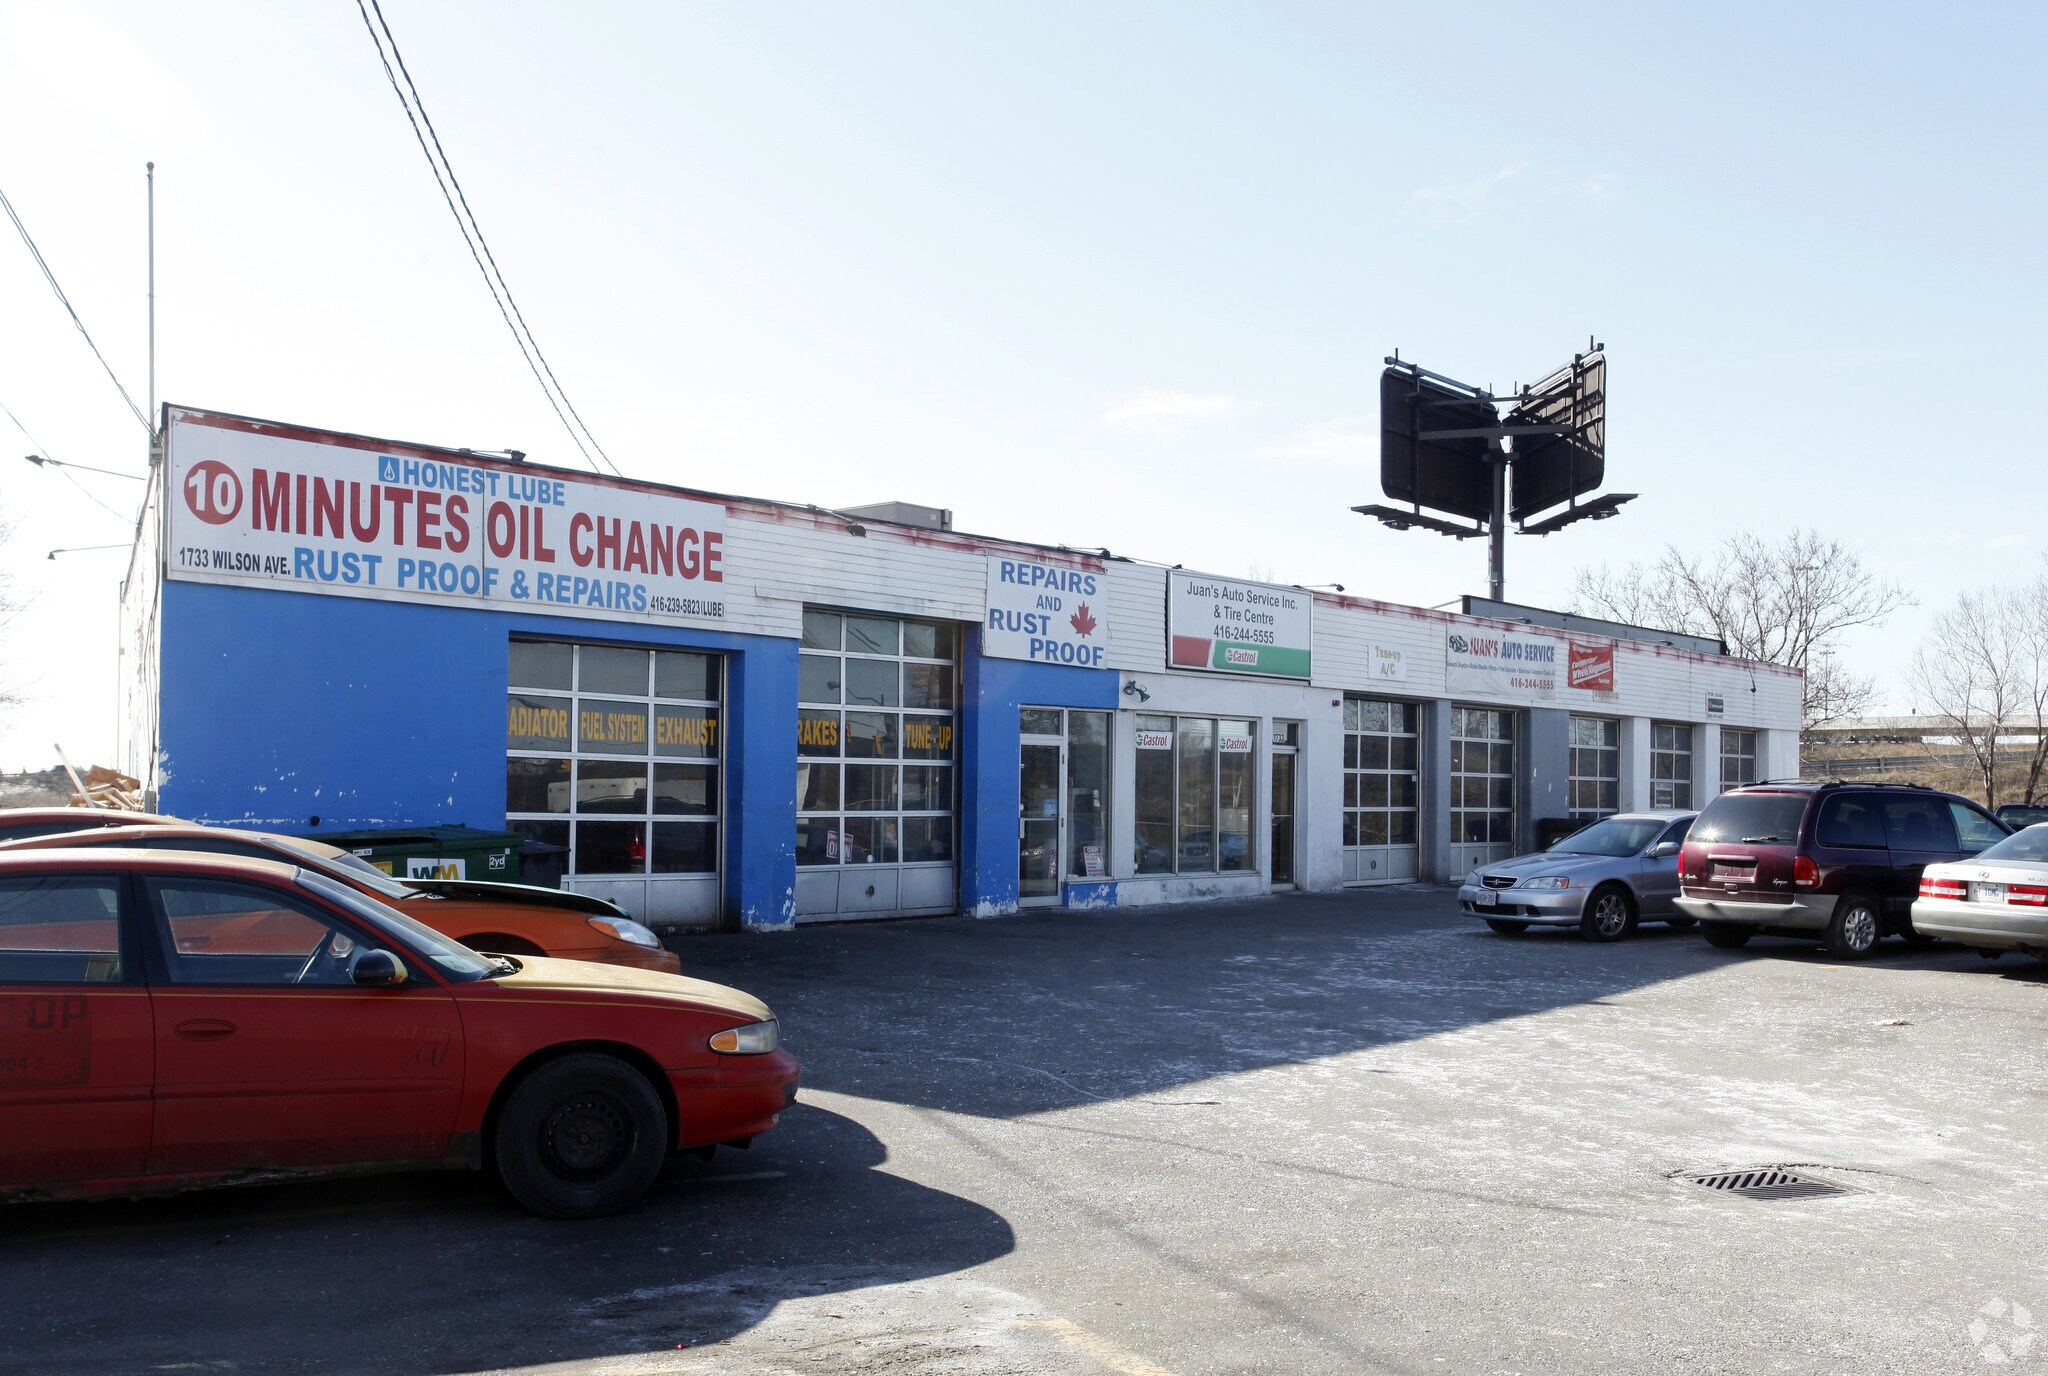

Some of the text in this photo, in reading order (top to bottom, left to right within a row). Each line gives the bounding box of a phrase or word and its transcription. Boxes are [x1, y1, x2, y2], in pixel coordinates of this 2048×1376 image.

[404, 459, 565, 506] HONEST LUBE
[189, 468, 723, 582] 10 MINUTES OIL CHANGE
[180, 547, 291, 575] 1733 WILSON AVE.
[294, 547, 647, 612] RUST PROOF & REPAIRS
[1001, 561, 1097, 596] REPAIRS
[1036, 595, 1062, 612] AND
[1187, 581, 1298, 610] Juan's Auto Service Inc.
[989, 608, 1051, 636] RUST
[1213, 604, 1274, 625] & Tire Centre
[1213, 624, 1275, 644] 416-244-5555
[1030, 638, 1104, 667] PROOF
[1233, 650, 1256, 664] Castrol
[1469, 638, 1554, 662] JUAN'S AUTO SERVICE
[1511, 678, 1554, 690] 416-244-5555
[581, 711, 605, 741] FUEL
[608, 713, 645, 742] SYSTEM
[657, 716, 716, 746] EXHAUST
[1143, 734, 1167, 747] Castrol
[1226, 738, 1248, 750] Castrol
[412, 863, 459, 880] WM
[489, 856, 504, 867] 2yd
